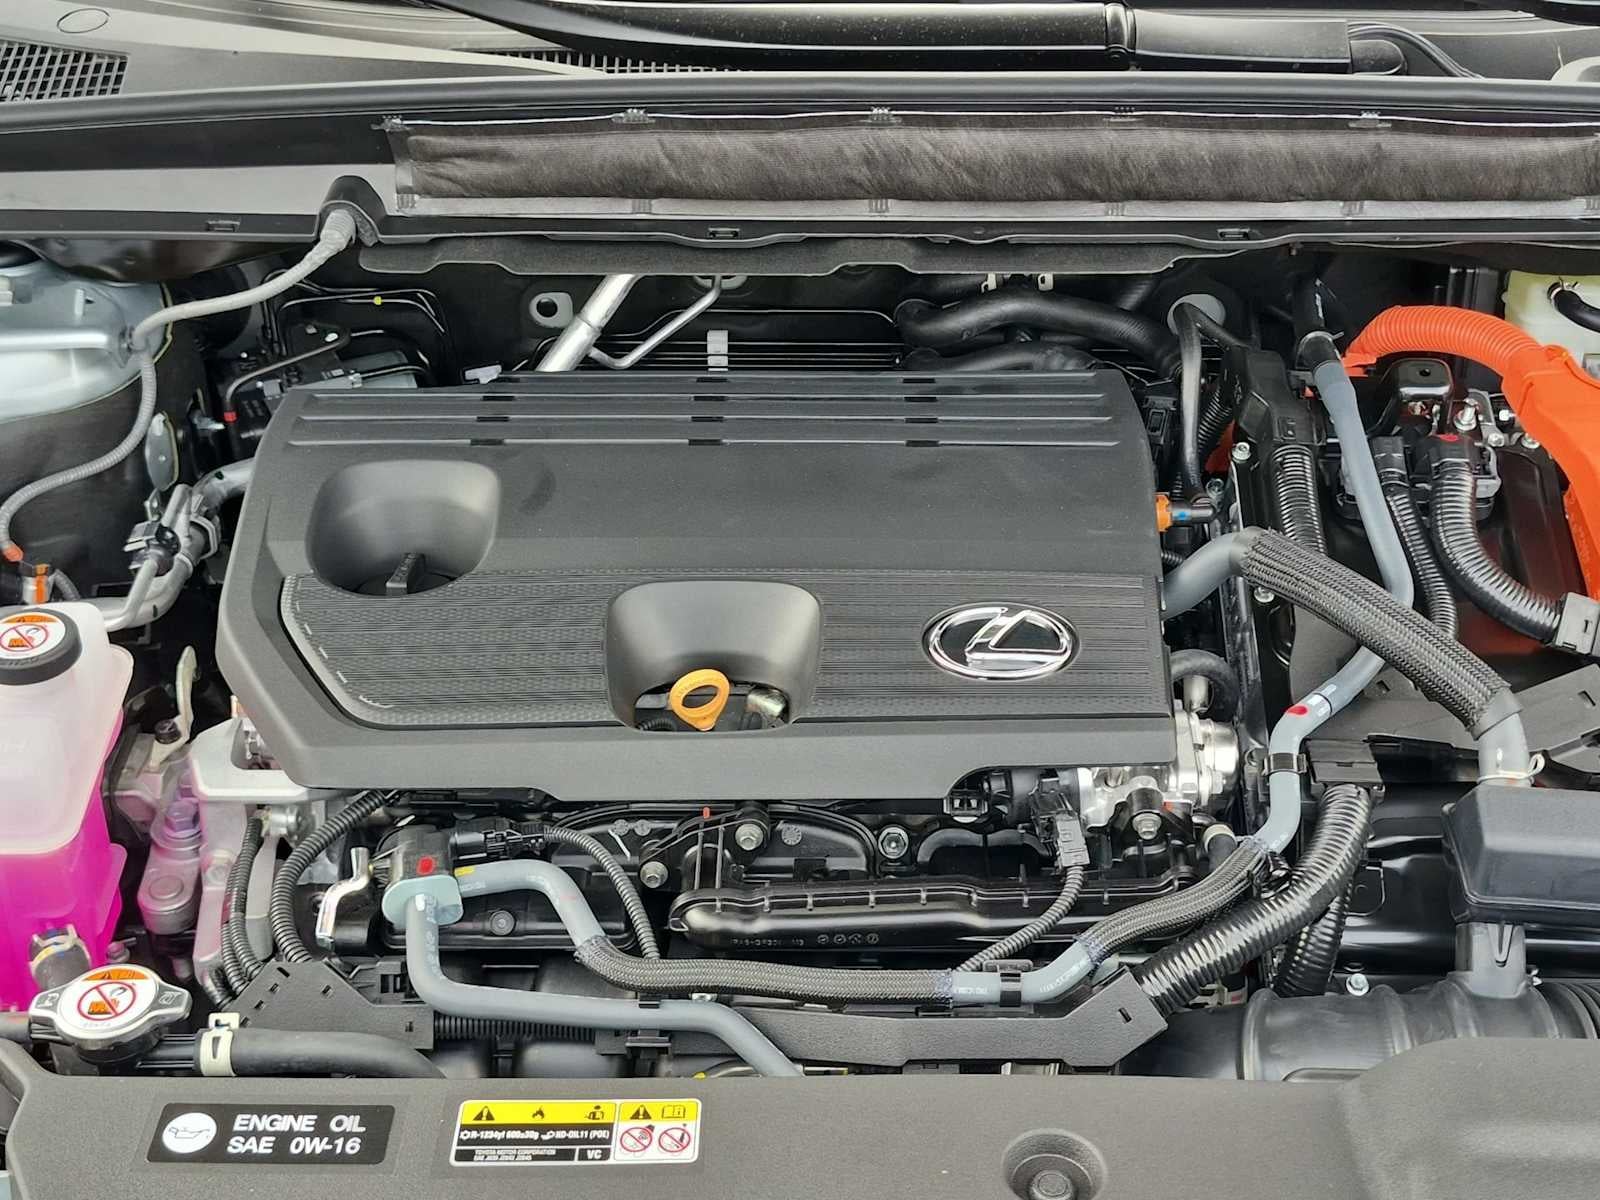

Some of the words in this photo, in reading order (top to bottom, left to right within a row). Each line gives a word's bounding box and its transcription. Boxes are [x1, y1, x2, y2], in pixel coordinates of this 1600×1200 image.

[233, 1114, 317, 1132] ENGINE
[331, 1114, 366, 1133] OIL
[227, 1136, 275, 1154] SAE
[290, 1137, 361, 1155] 0W-16
[586, 1149, 602, 1160] VC
